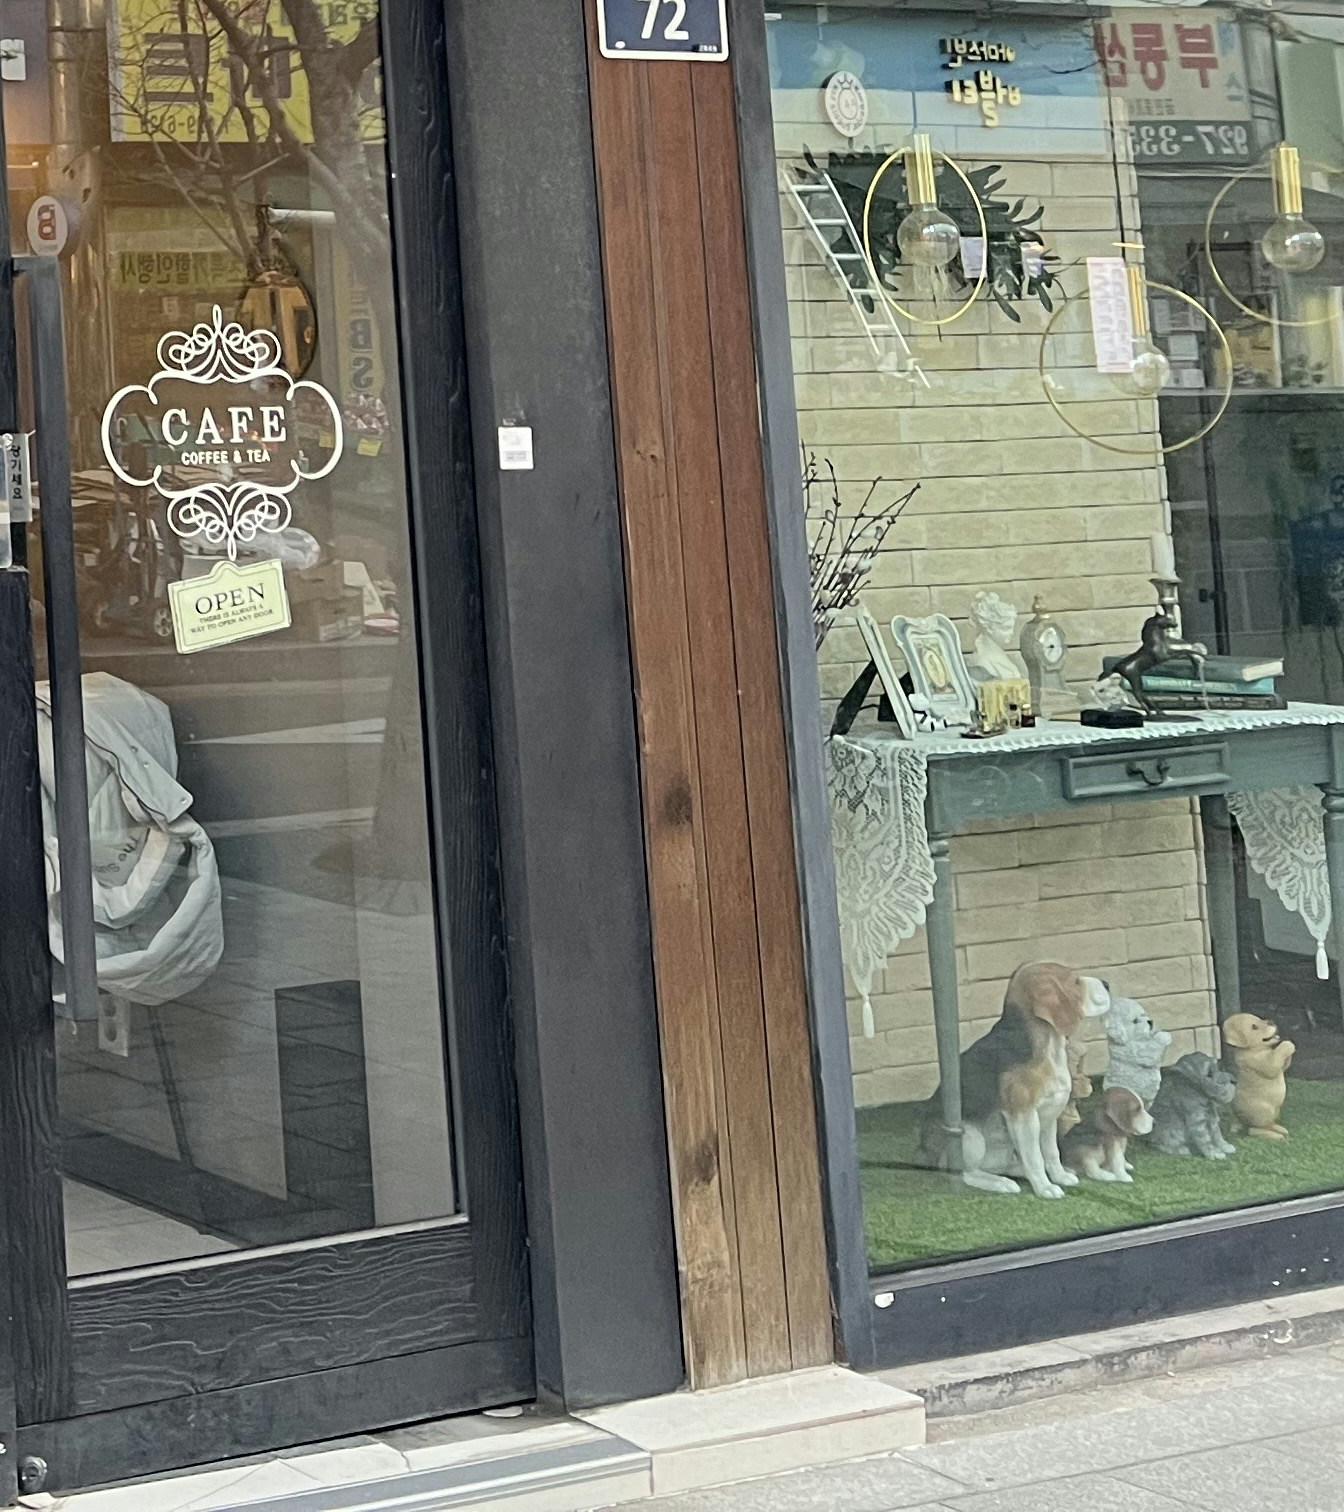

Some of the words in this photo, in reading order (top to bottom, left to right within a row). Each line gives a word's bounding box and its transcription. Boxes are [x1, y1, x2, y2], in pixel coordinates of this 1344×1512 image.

[162, 406, 287, 446] CAFE
[181, 451, 228, 466] COFFEE
[246, 449, 271, 463] TEA
[195, 583, 265, 614] OPEN
